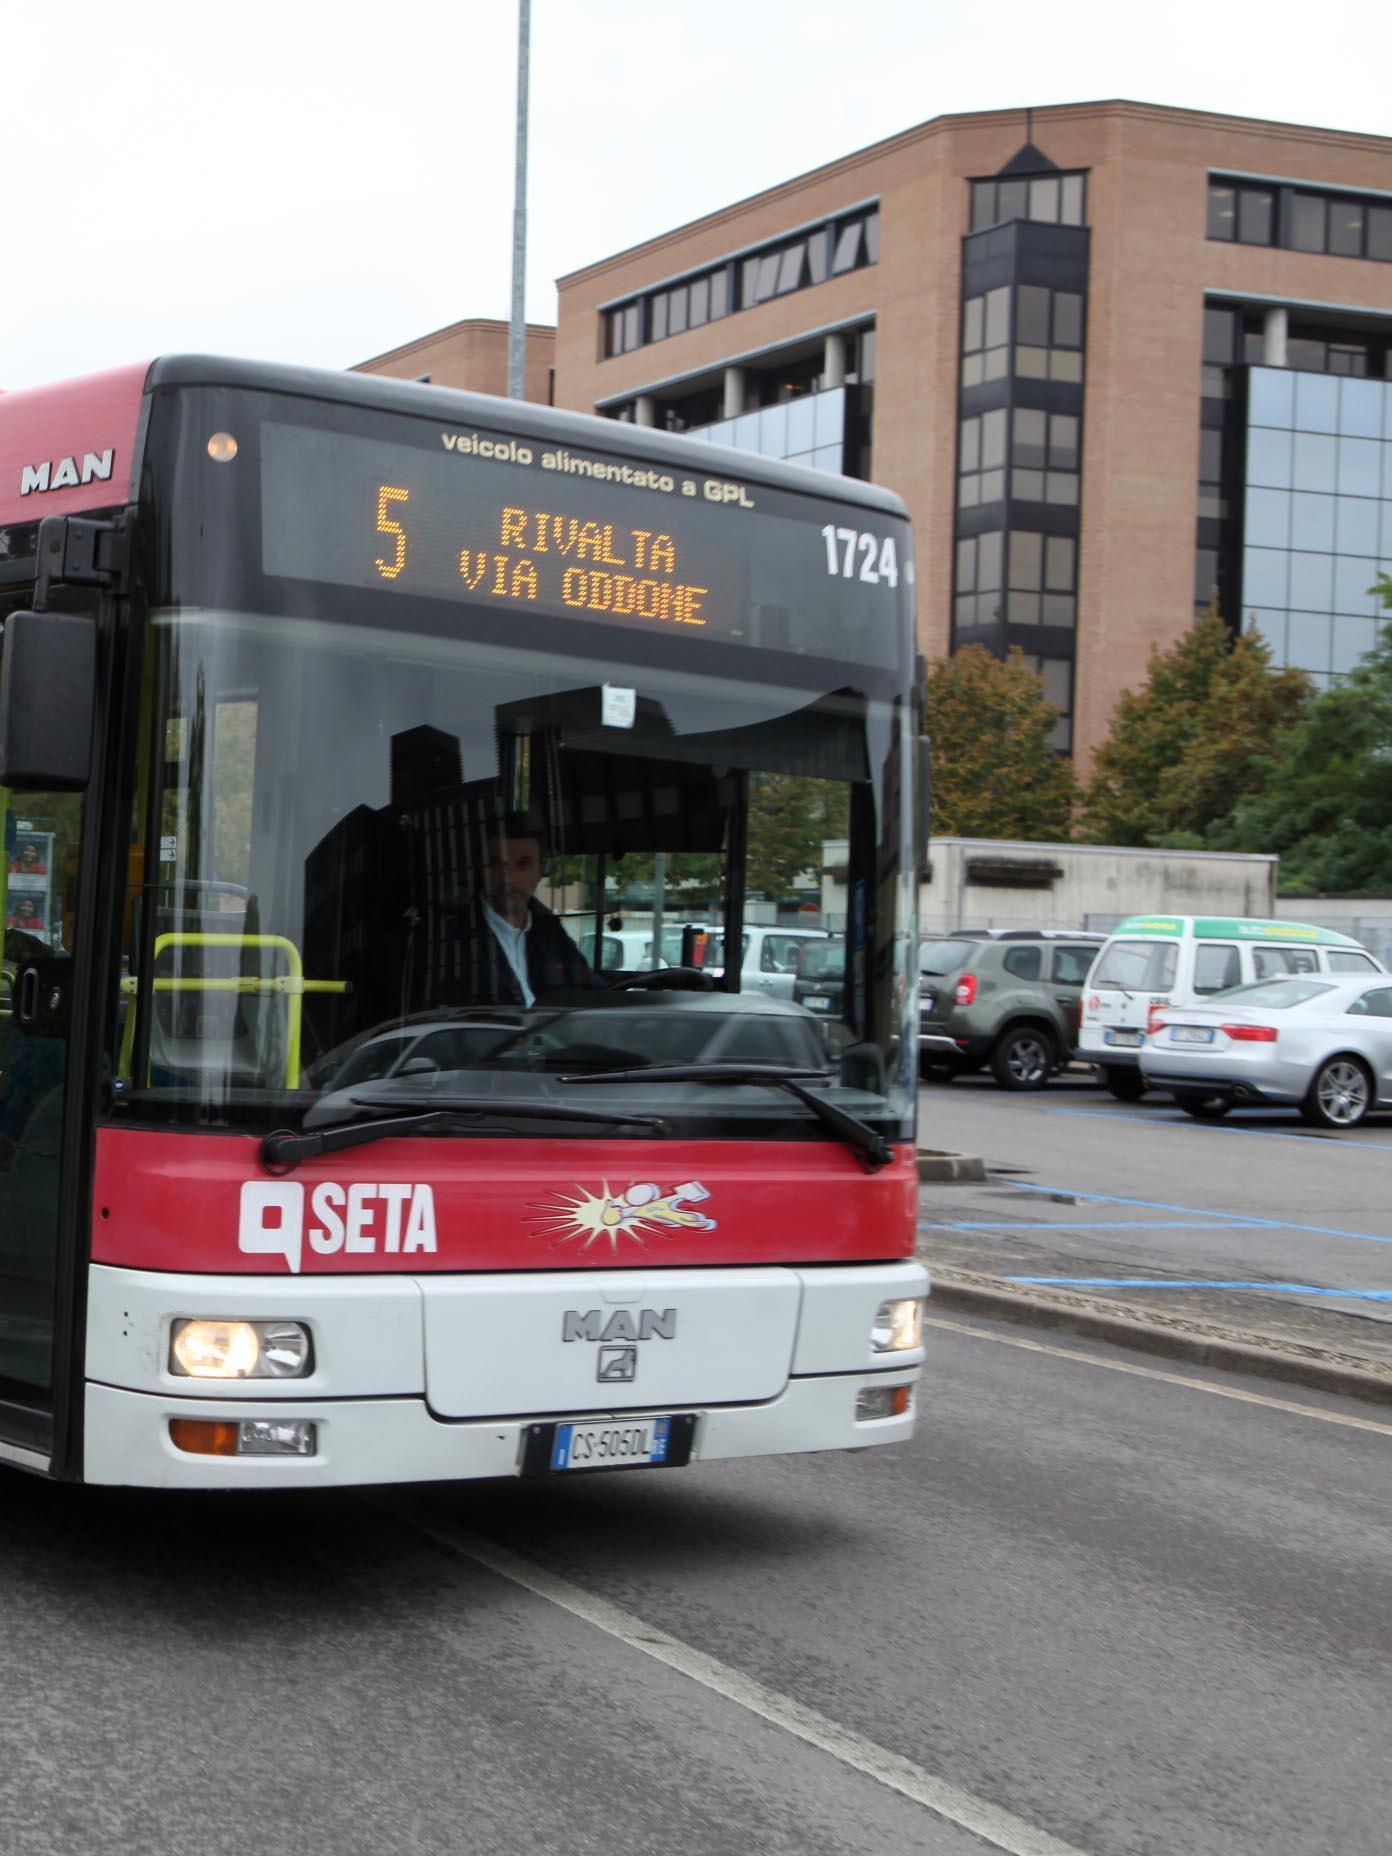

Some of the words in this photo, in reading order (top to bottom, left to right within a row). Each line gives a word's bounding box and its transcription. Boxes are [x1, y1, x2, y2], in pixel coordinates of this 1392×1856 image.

[20, 448, 115, 497] MAN
[441, 433, 533, 465] veicolo
[541, 450, 674, 493] alimentato
[681, 479, 697, 497] a
[704, 479, 755, 508] GPL
[375, 486, 409, 578] 5
[501, 508, 676, 574] RIVALTA
[821, 524, 898, 588] 1724
[460, 549, 538, 600] VIA
[309, 1181, 438, 1255] SETA
[561, 1308, 677, 1342] MAN
